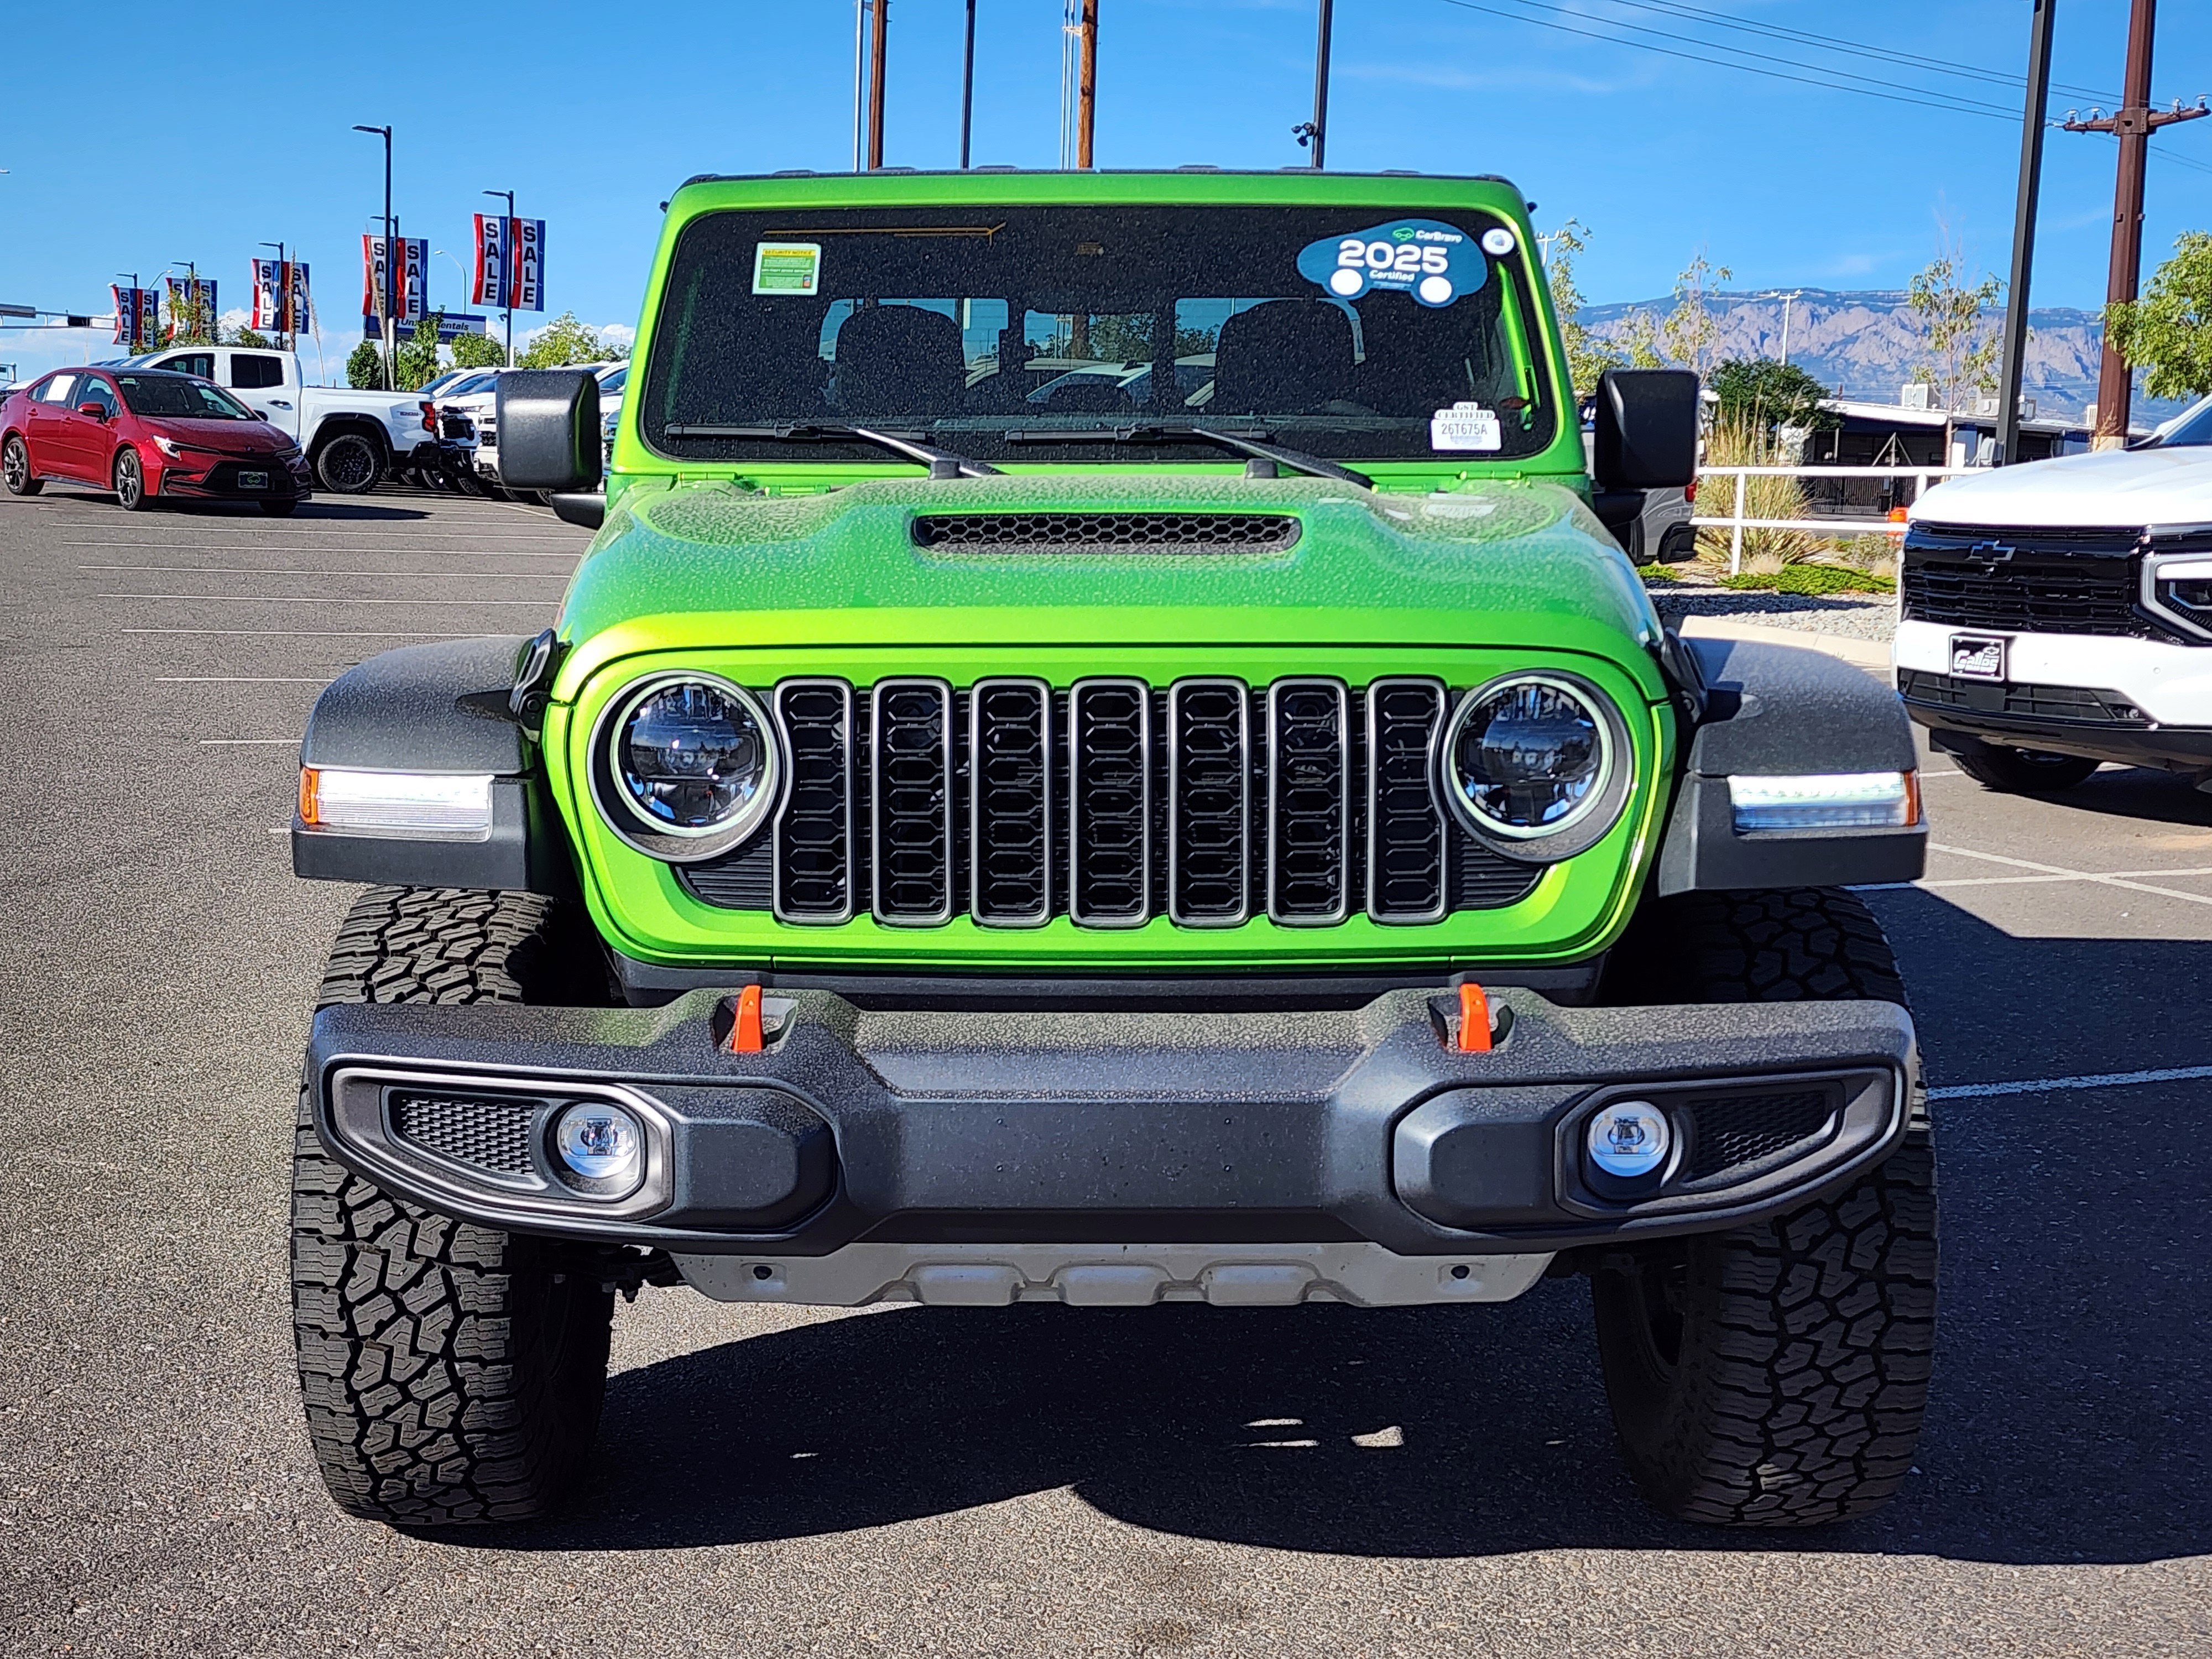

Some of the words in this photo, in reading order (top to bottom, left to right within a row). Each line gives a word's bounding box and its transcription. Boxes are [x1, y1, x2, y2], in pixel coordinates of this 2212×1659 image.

[407, 245, 420, 314] SALE
[485, 222, 499, 299] SALE
[523, 226, 537, 303] SALE
[1338, 239, 1448, 274] 2025
[1369, 269, 1415, 282] Certified
[120, 292, 131, 341] SALE
[262, 265, 273, 327] SALE
[439, 322, 469, 331] entals
[1441, 422, 1488, 435] 26T675A
